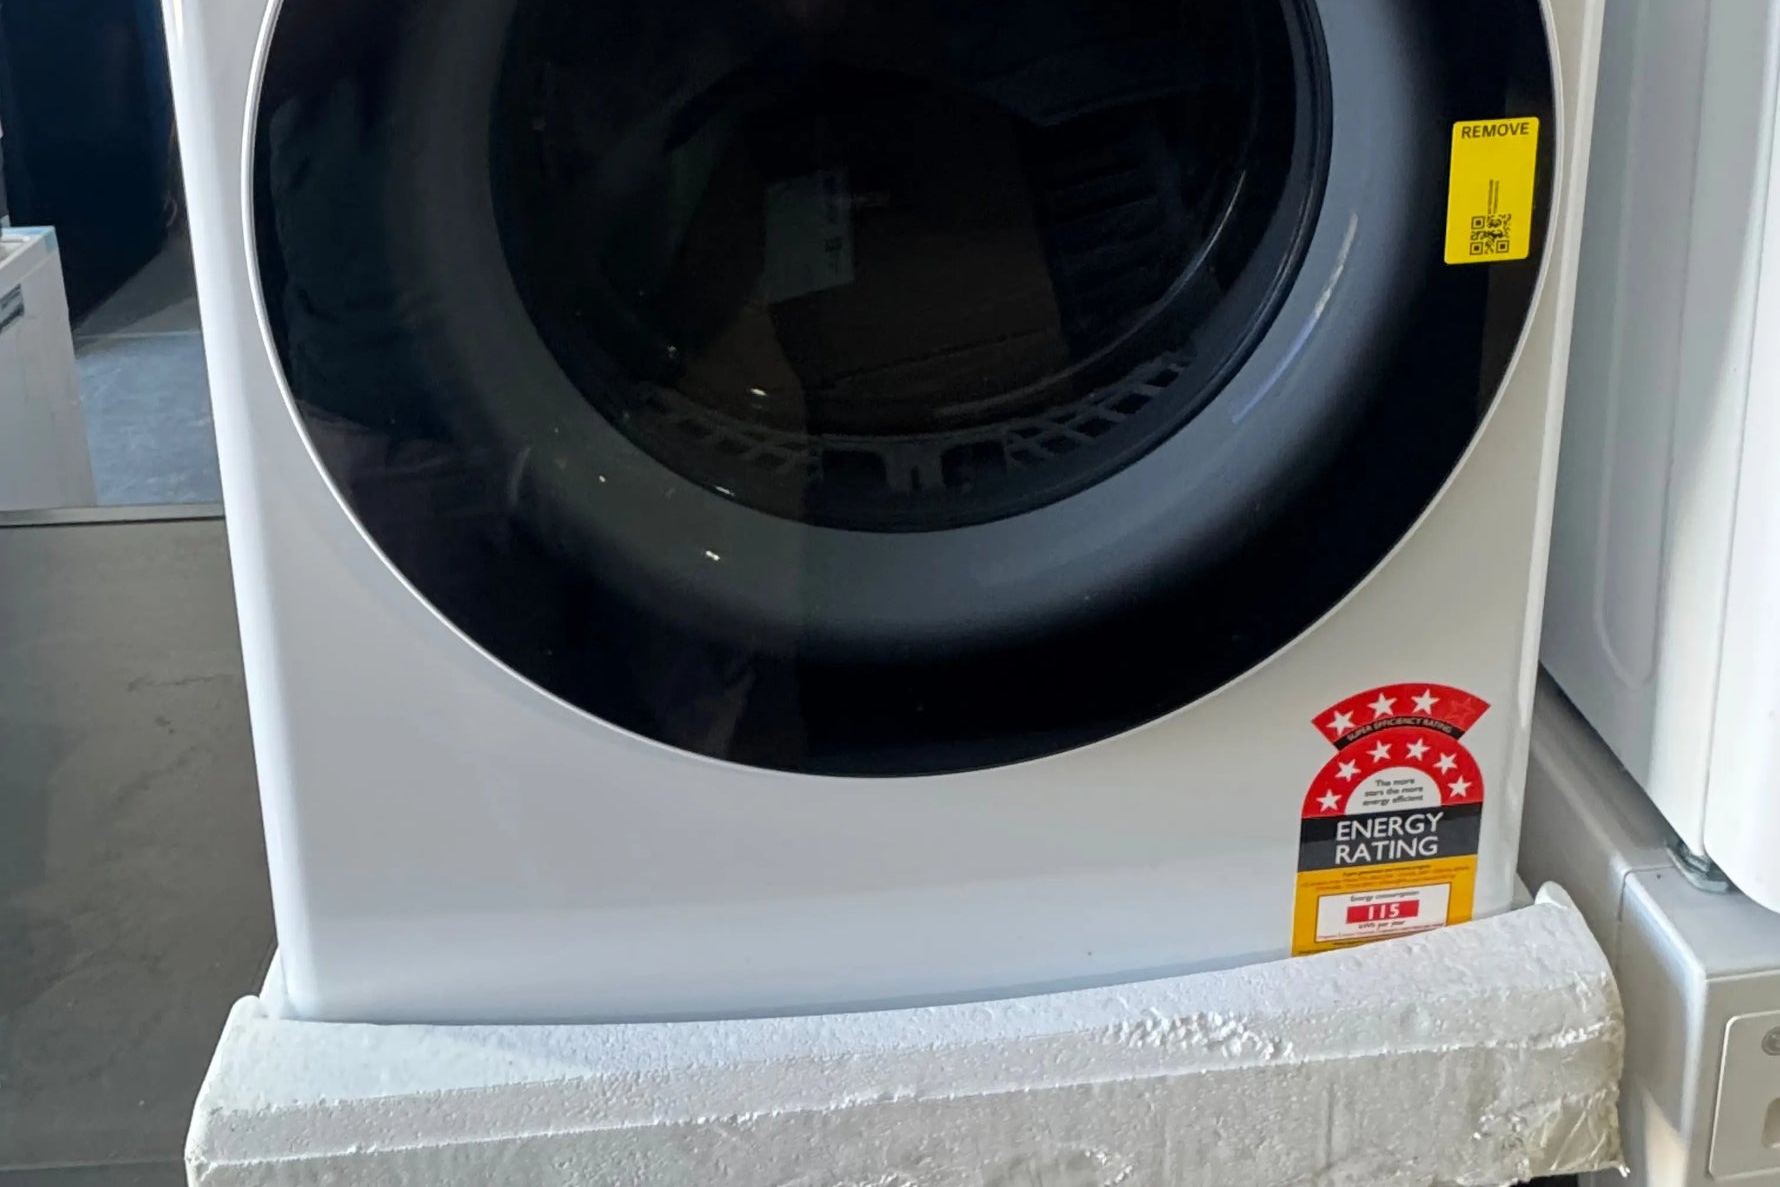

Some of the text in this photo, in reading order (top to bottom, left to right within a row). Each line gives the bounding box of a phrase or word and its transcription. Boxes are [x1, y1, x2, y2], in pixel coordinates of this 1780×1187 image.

[1461, 122, 1530, 139] REMOVE
[1375, 779, 1391, 787] The
[1386, 786, 1400, 795] the
[1336, 811, 1444, 842] ENERGY
[1335, 836, 1439, 865] RATING
[1350, 891, 1374, 903] Energy
[1368, 903, 1401, 920] 115
